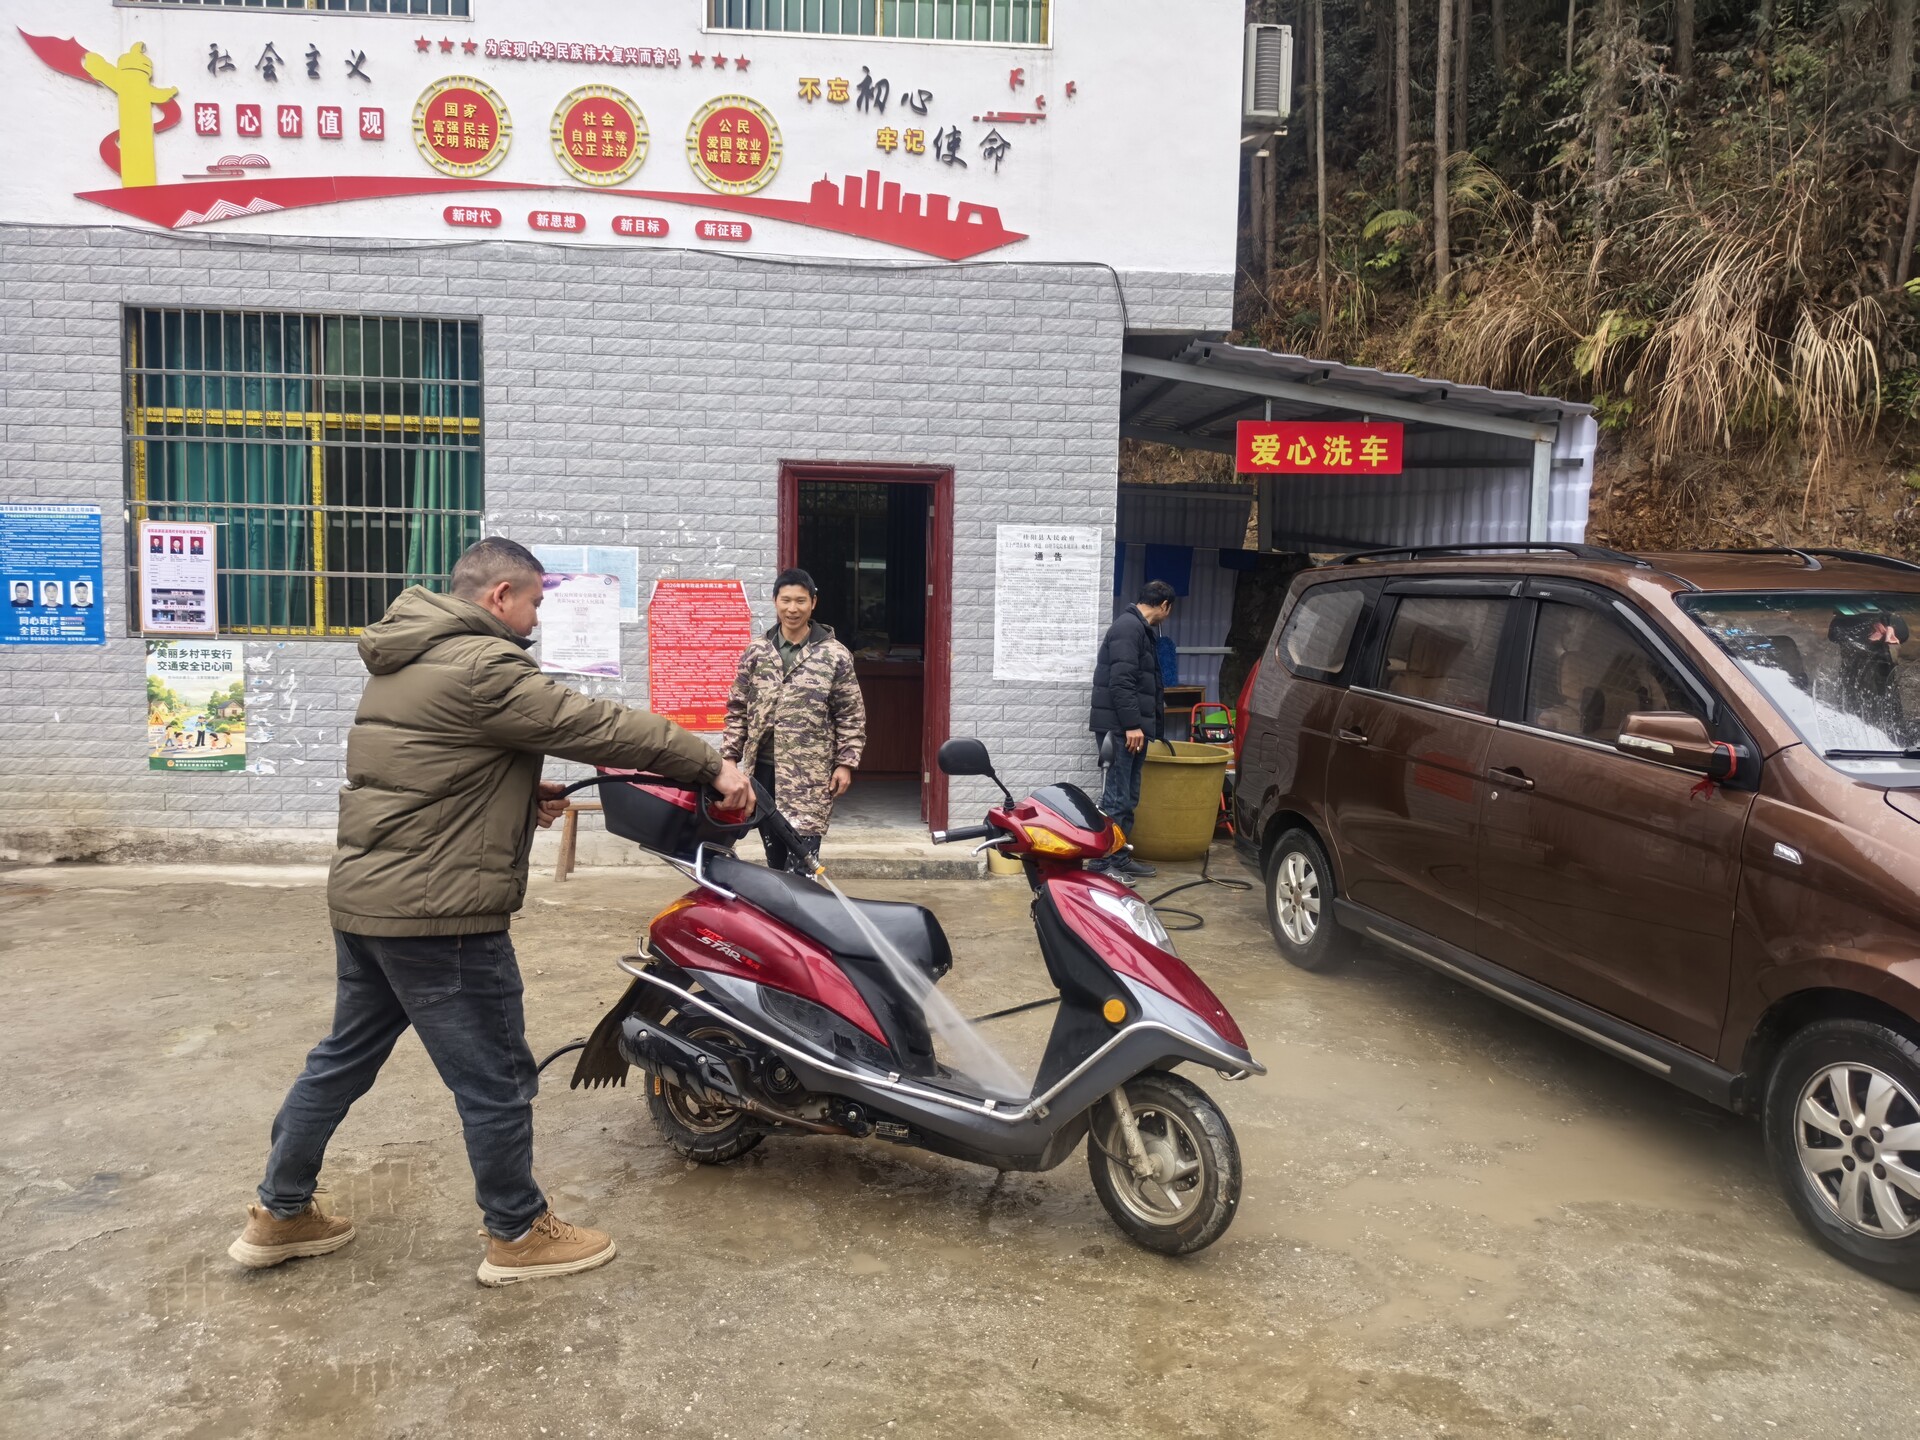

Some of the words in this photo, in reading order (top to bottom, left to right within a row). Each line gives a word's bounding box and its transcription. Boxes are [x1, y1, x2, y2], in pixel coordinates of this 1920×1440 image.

[485, 39, 680, 67] 为实现中华民族伟大复兴而奋斗
[207, 41, 371, 82] 社会主义
[798, 65, 933, 116] 不忘初心
[444, 102, 477, 118] 国家
[197, 106, 382, 135] 核心价值观
[582, 111, 615, 127] 社会
[718, 118, 750, 135] 公民
[432, 119, 489, 136] 富强民主
[433, 134, 489, 151] 文明和谐
[571, 128, 628, 144] 自由平等
[706, 135, 762, 152] 爱国敬业
[571, 142, 628, 158] 公正法治
[876, 125, 1011, 173] 牢记使命
[706, 149, 762, 166] 诚信友善
[452, 208, 493, 223] 新时代
[536, 213, 577, 228] 新思想
[620, 218, 660, 233] 新目标
[703, 222, 743, 238] 新征程
[1250, 433, 1389, 467] 爱心洗车
[1034, 551, 1063, 562] 通告
[19, 626, 60, 636] 全民反诈
[156, 648, 233, 659] 美丽乡村平安行
[157, 661, 233, 672] 交通安全记心间
[696, 936, 743, 963] STAR
